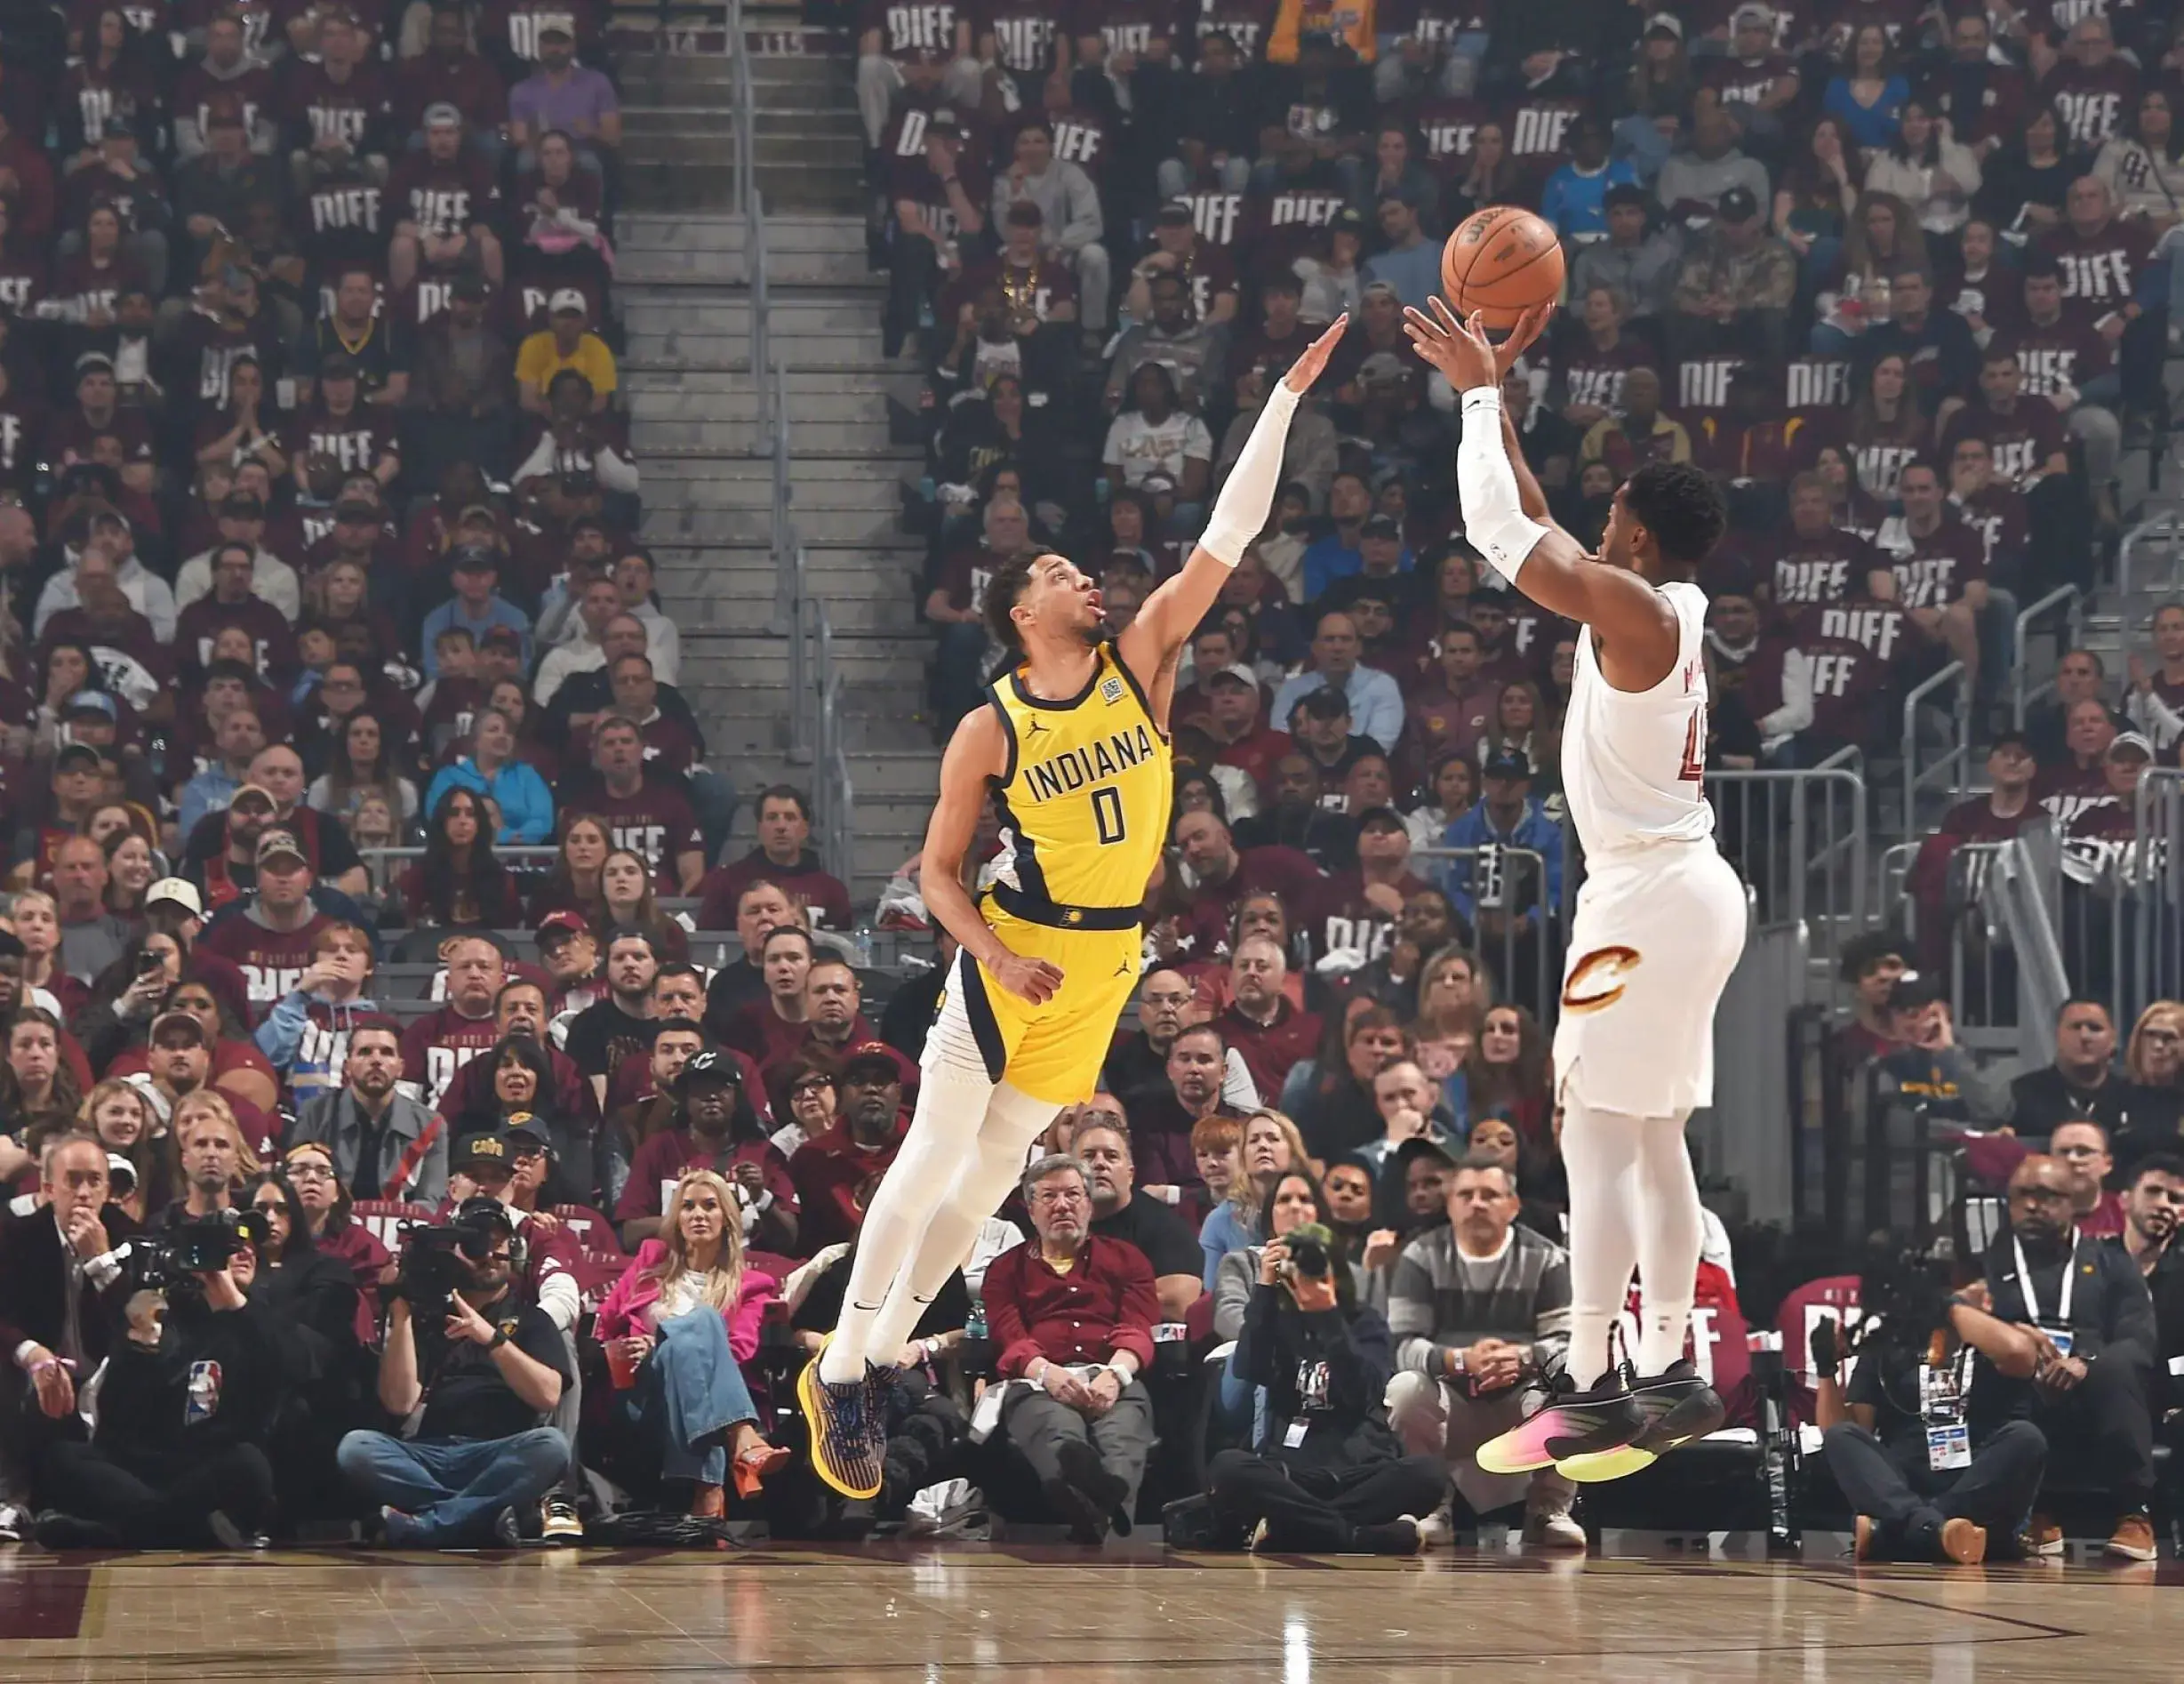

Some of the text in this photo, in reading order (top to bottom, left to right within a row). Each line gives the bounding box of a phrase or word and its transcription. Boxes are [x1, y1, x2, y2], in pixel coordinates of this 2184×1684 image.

[887, 5, 956, 51] DIFF
[1051, 122, 1102, 164] IFF
[1511, 107, 1582, 156] DIF
[1679, 360, 1744, 411] DIF
[1821, 607, 1904, 661] DIFF
[1022, 725, 1156, 804] INDIANA
[1090, 786, 1126, 847] 0
